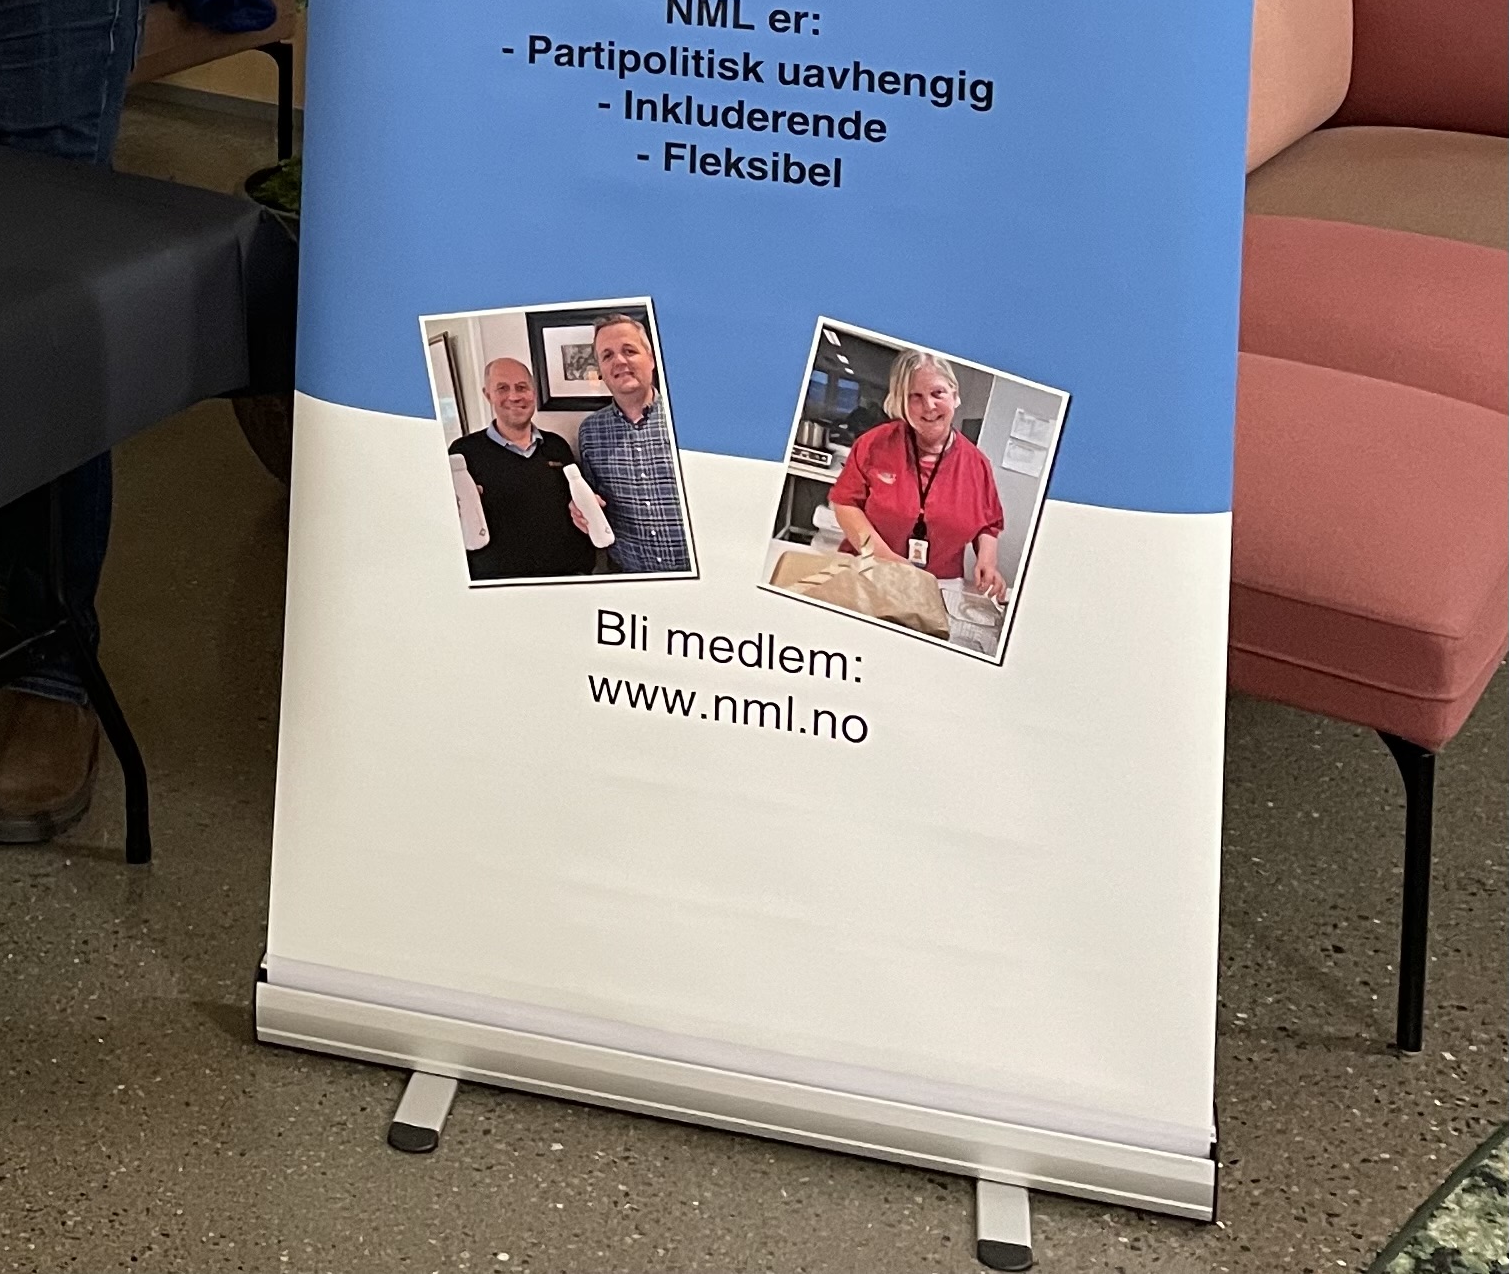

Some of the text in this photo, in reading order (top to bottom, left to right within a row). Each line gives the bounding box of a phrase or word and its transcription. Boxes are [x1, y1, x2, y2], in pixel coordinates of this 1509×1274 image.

[769, 10, 821, 36] er:
[529, 34, 765, 84] Partipolitisk
[778, 60, 994, 112] uavhengig
[624, 89, 887, 143] Inkluderende
[665, 141, 842, 188] Fleksibel
[596, 608, 862, 684] Bli medlem:
[587, 674, 869, 744] www.nml.no
